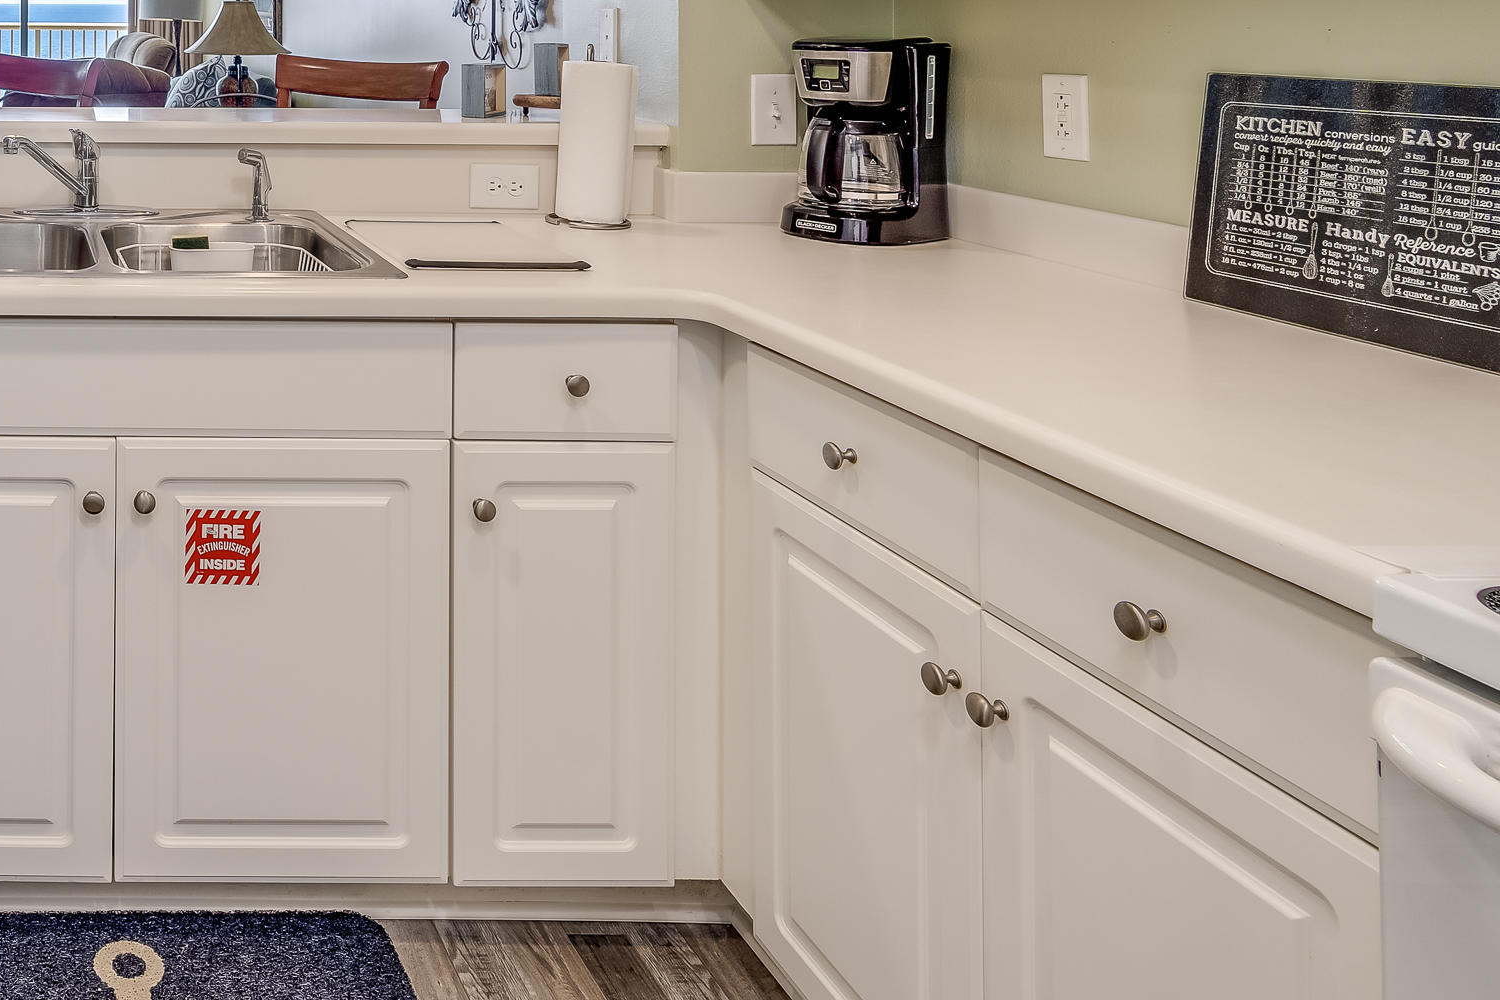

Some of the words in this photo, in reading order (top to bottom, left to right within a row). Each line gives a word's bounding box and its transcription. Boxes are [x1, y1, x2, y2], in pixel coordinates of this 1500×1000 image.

[1235, 116, 1323, 136] KITCHEN
[1324, 130, 1396, 144] conversions
[1234, 132, 1269, 141] convert
[1270, 135, 1304, 145] recipes
[1305, 138, 1342, 151] quickly
[1342, 142, 1364, 150] and
[1366, 144, 1392, 156] easy
[1401, 128, 1472, 148] EASY
[1234, 142, 1250, 152] Cup
[1451, 157, 1469, 165] tbsp
[1411, 167, 1429, 176] tbsp
[1456, 172, 1472, 180] cup
[1409, 180, 1427, 188] tbsp
[1439, 182, 1452, 190] 1/4
[1454, 185, 1470, 193] cup
[1409, 191, 1427, 200] tbsp
[1438, 195, 1452, 203] 1/2
[1411, 205, 1429, 214] tbsp
[1453, 211, 1469, 219] cup
[1226, 208, 1309, 232] MEASURE
[1410, 217, 1427, 227] tbsp
[1446, 223, 1462, 231] cup
[1325, 222, 1390, 248] Handy
[1394, 234, 1476, 257] Reference
[1334, 242, 1356, 252] drops
[1372, 249, 1385, 257] tsp
[1363, 266, 1379, 274] cup
[1398, 252, 1500, 279] EQUIVALENTS
[1286, 270, 1299, 278] cup
[1326, 277, 1340, 285] cup
[1403, 266, 1424, 275] cups
[1441, 272, 1460, 281] pint
[1402, 277, 1425, 285] pints
[1441, 284, 1468, 293] quart
[1403, 290, 1432, 300] quarts
[1449, 299, 1478, 309] gallon
[201, 524, 244, 539] FIRE
[196, 541, 250, 557] EXTINGUISHER
[200, 558, 246, 570] INSIDE
